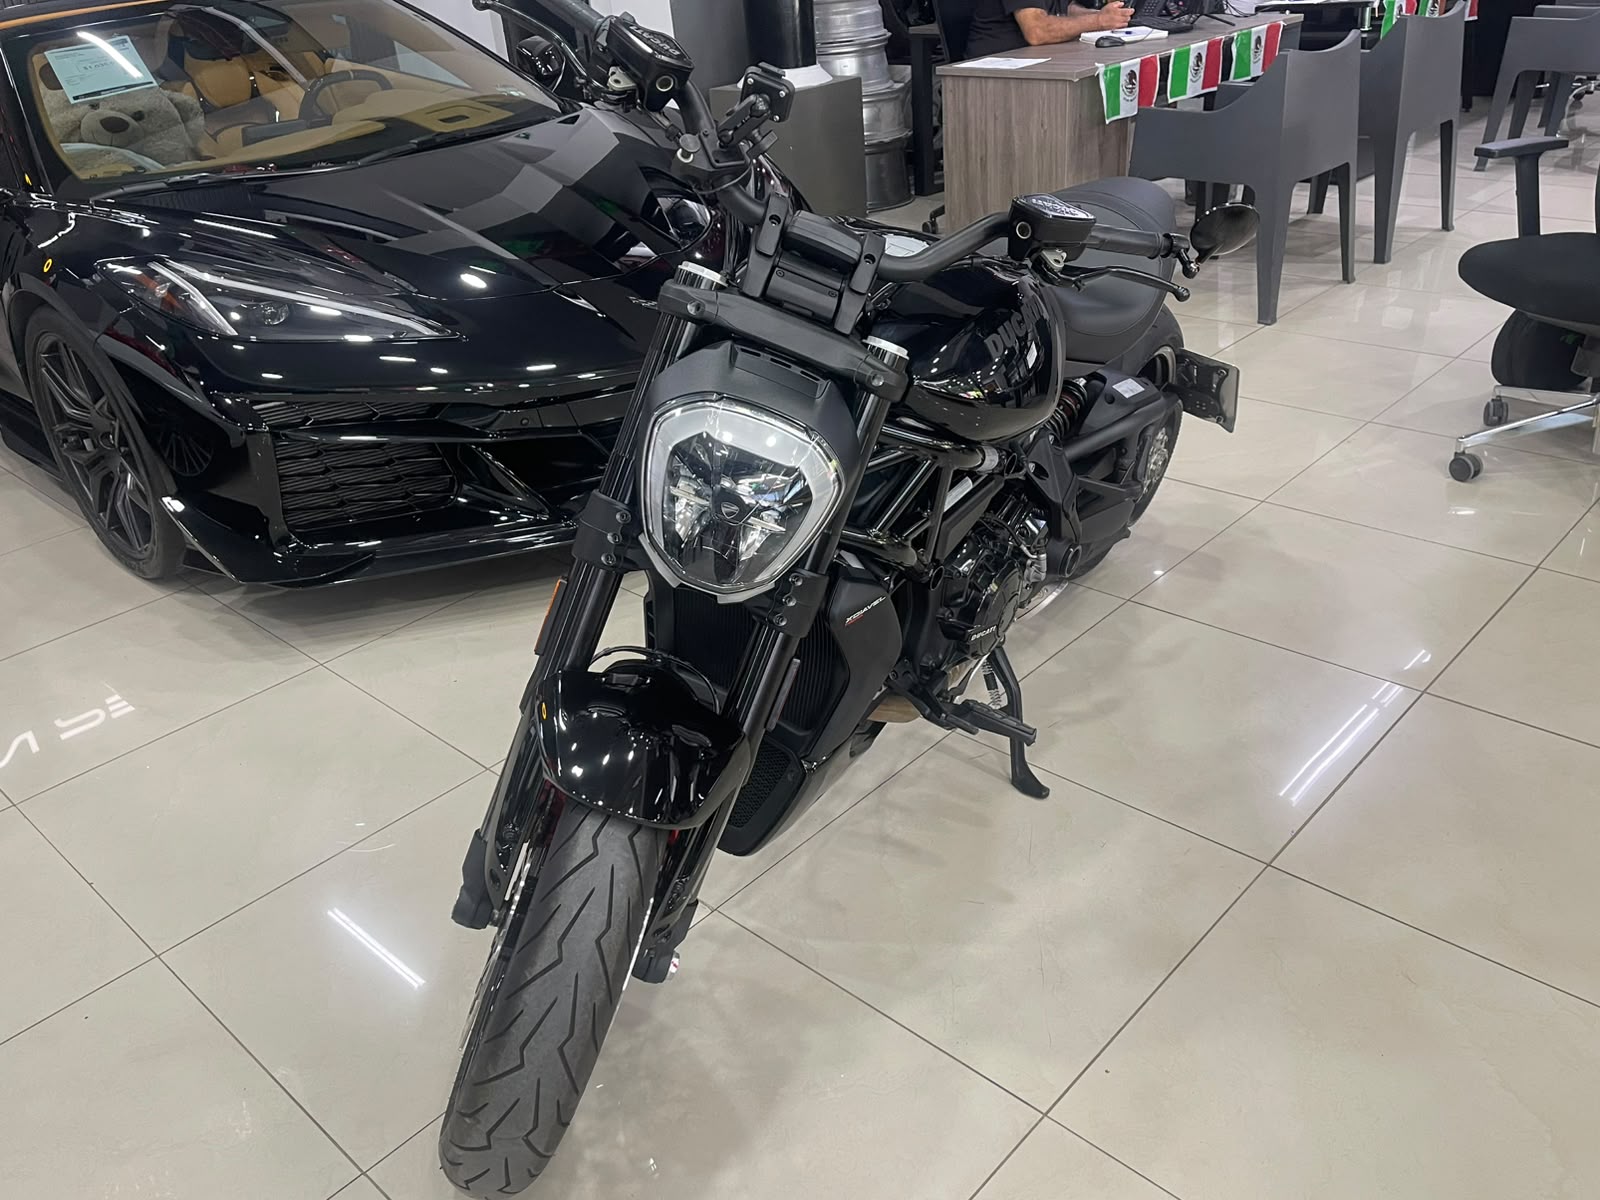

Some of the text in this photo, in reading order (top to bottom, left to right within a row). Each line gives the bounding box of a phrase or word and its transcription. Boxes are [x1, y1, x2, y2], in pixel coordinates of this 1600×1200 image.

[629, 25, 681, 56] DUCATI
[845, 596, 887, 625] XDIAVEL
[970, 625, 997, 641] DUCATI
